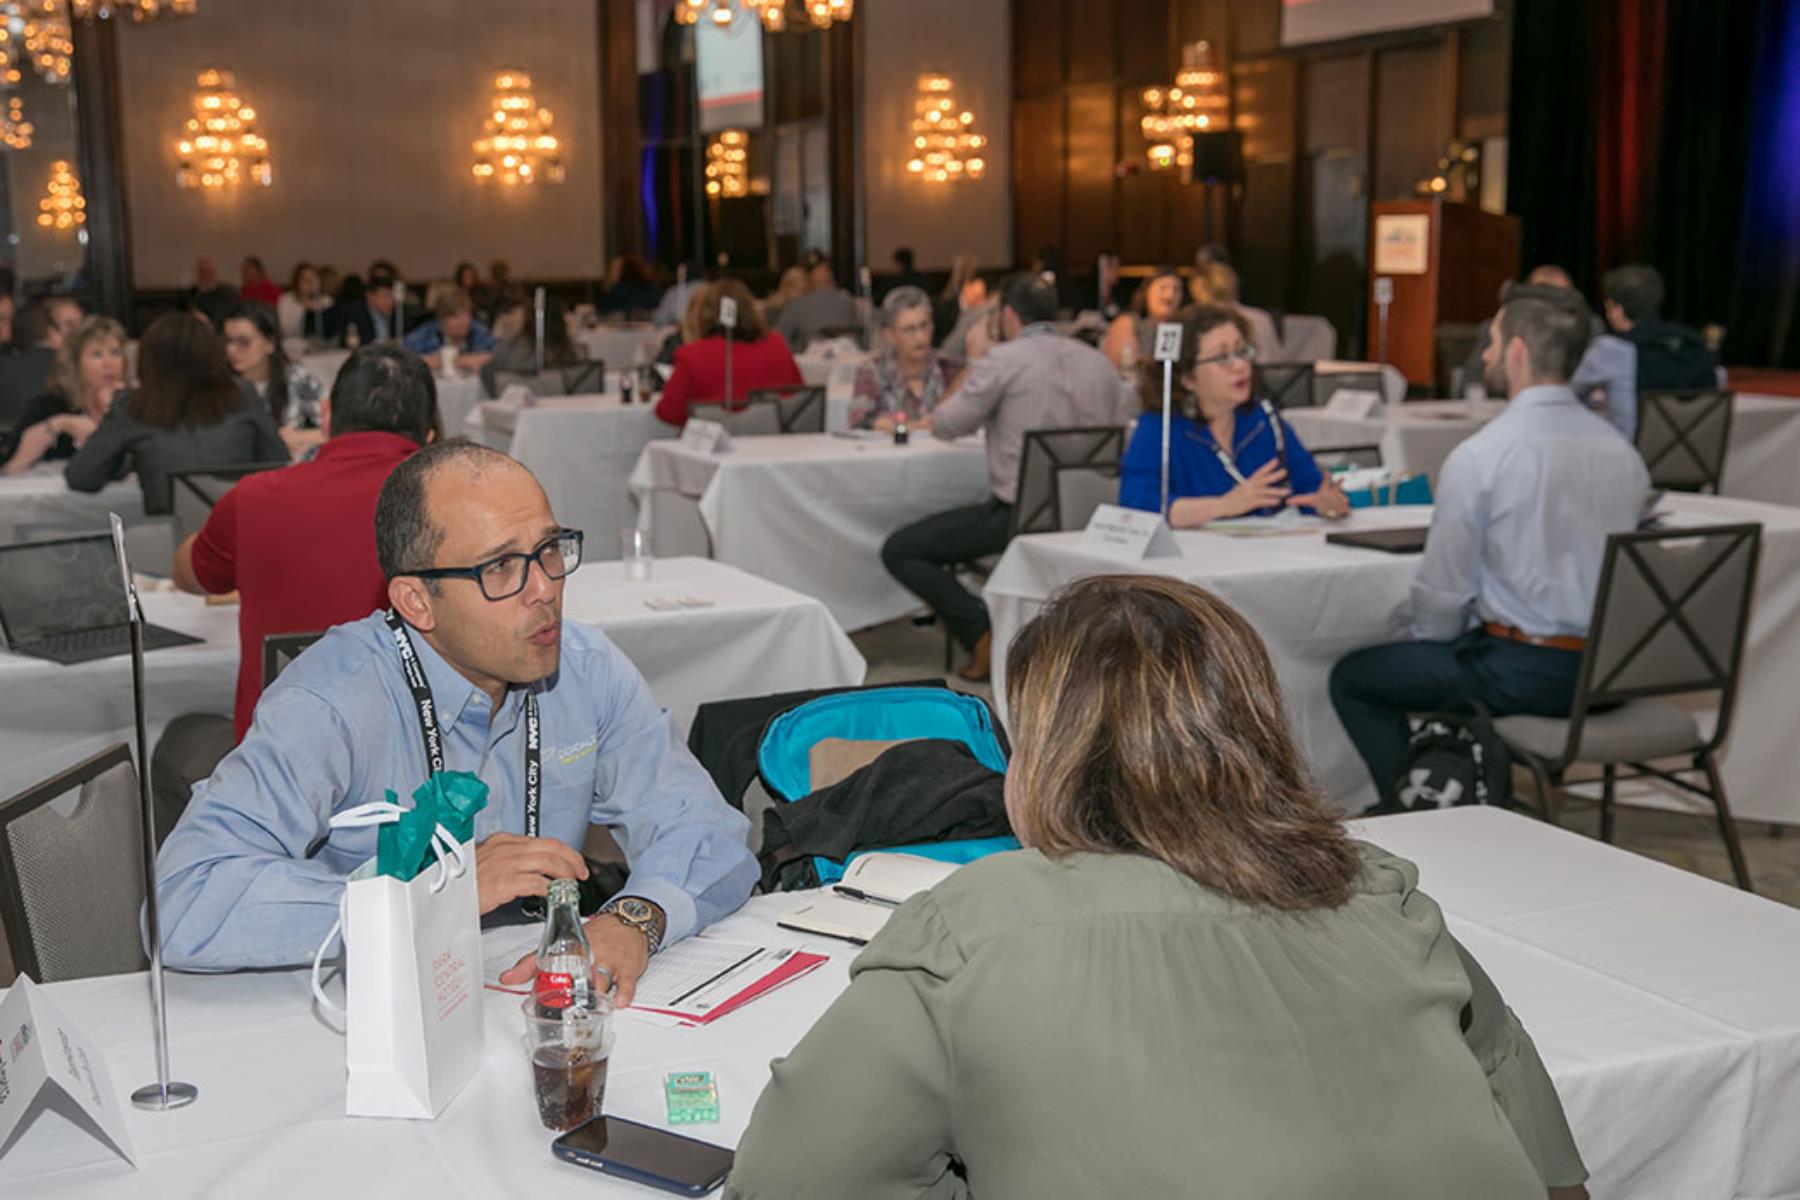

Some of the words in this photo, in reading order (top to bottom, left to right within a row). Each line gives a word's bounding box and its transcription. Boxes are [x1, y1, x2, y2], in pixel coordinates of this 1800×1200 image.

[394, 626, 413, 660] NYC
[420, 698, 433, 727] New
[426, 727, 441, 757] York
[528, 717, 539, 750] NYC
[528, 759, 539, 785] City
[527, 786, 537, 814] York
